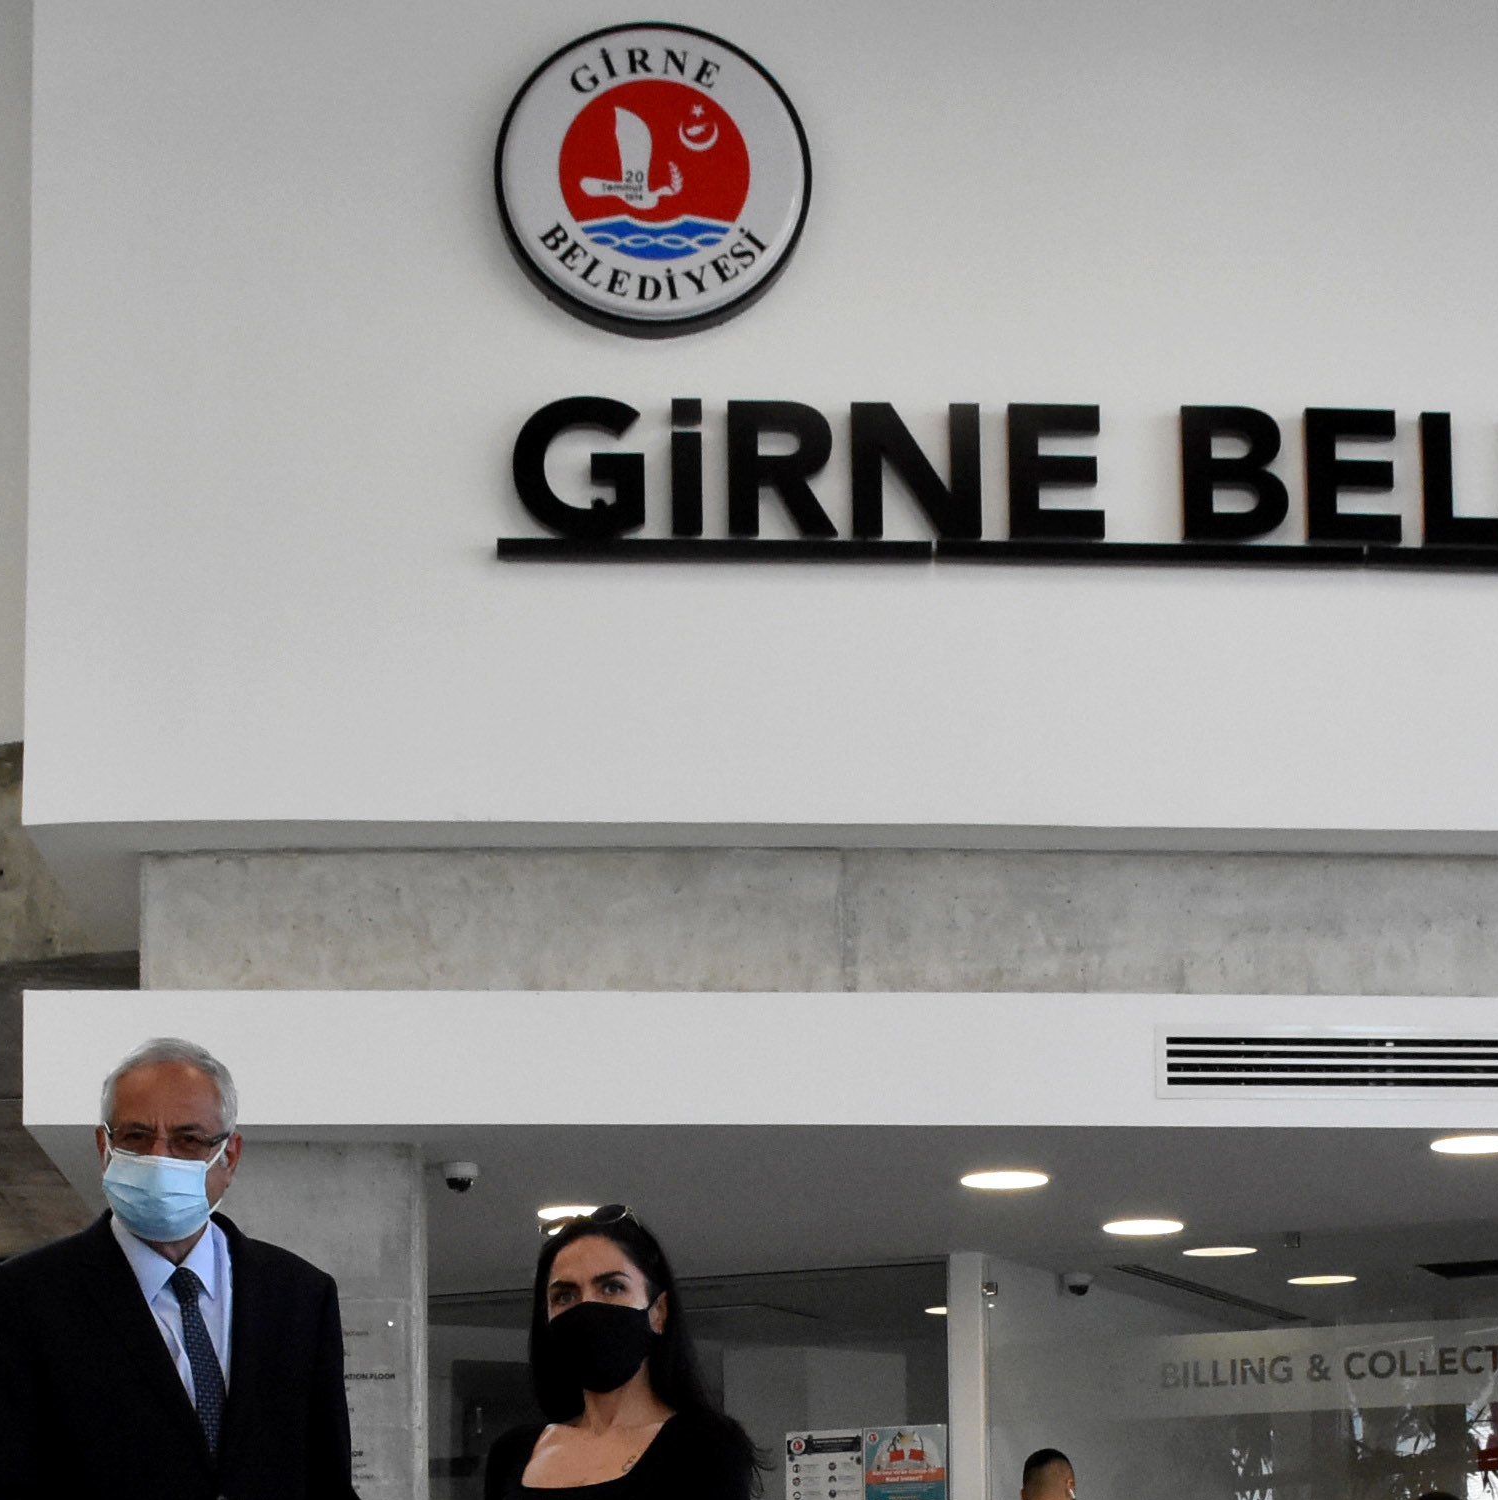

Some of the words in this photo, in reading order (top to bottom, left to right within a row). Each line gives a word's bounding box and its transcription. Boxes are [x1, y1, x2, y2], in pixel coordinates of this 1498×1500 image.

[570, 47, 720, 93] GİRNE
[625, 170, 644, 182] 20
[539, 220, 770, 301] BELEDİYESİ
[1160, 1353, 1295, 1389] BILLING
[1307, 1353, 1332, 1383] &
